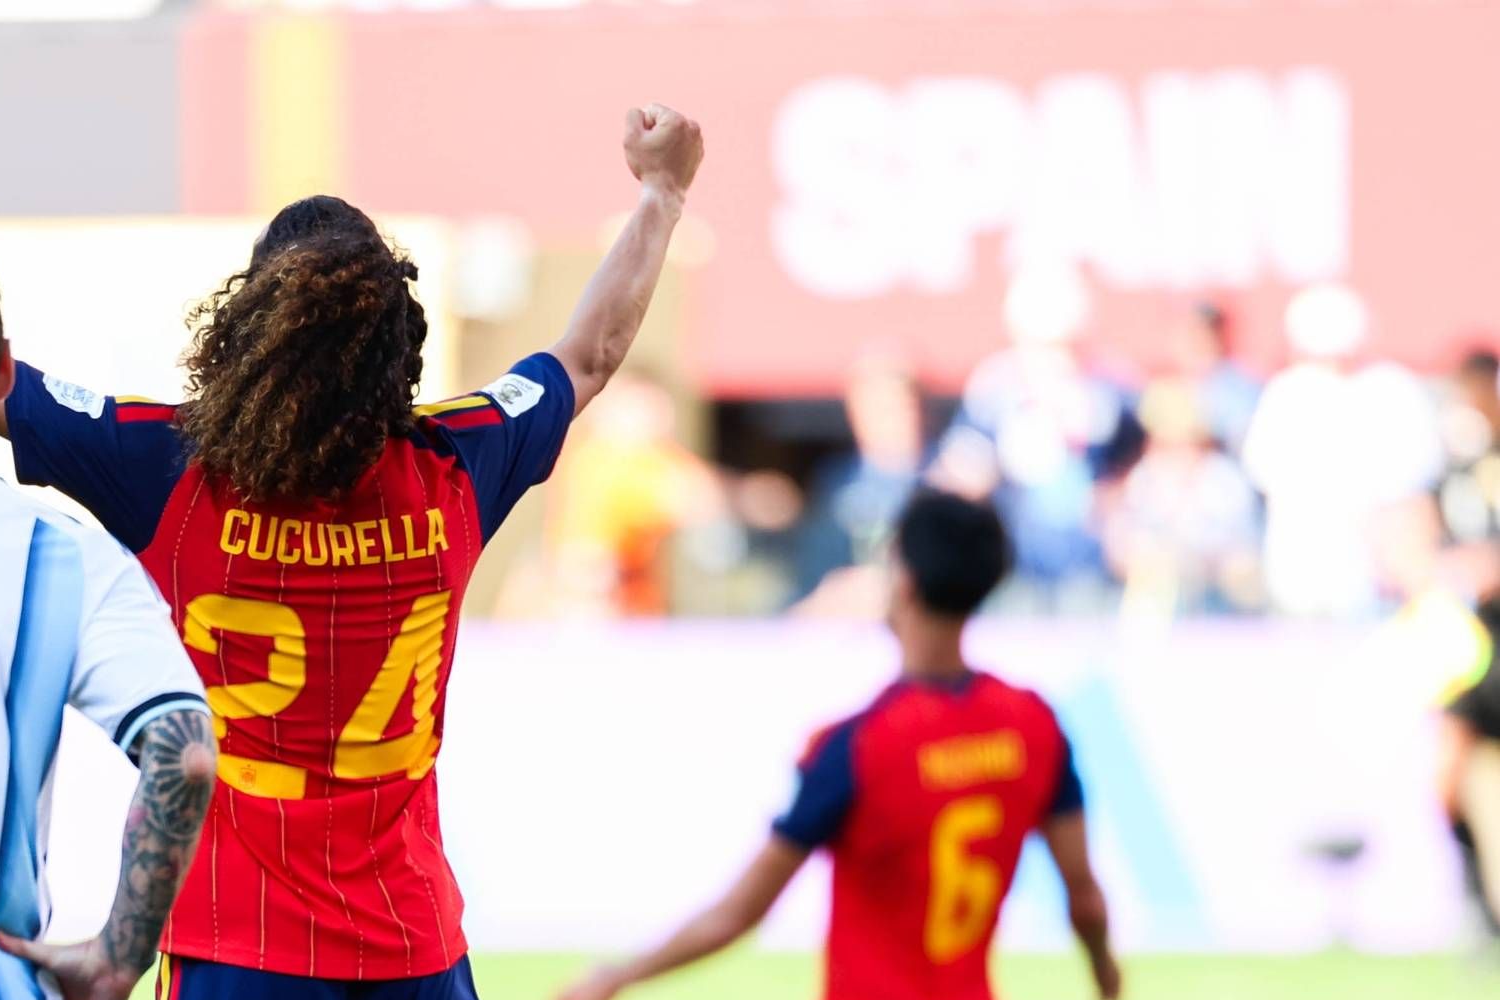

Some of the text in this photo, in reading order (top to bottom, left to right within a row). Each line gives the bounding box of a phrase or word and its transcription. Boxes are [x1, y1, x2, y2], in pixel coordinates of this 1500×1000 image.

[774, 70, 1348, 293] SPAIN
[220, 508, 449, 566] CUCURELLA
[183, 589, 452, 801] 24
[924, 796, 1002, 964] 6
